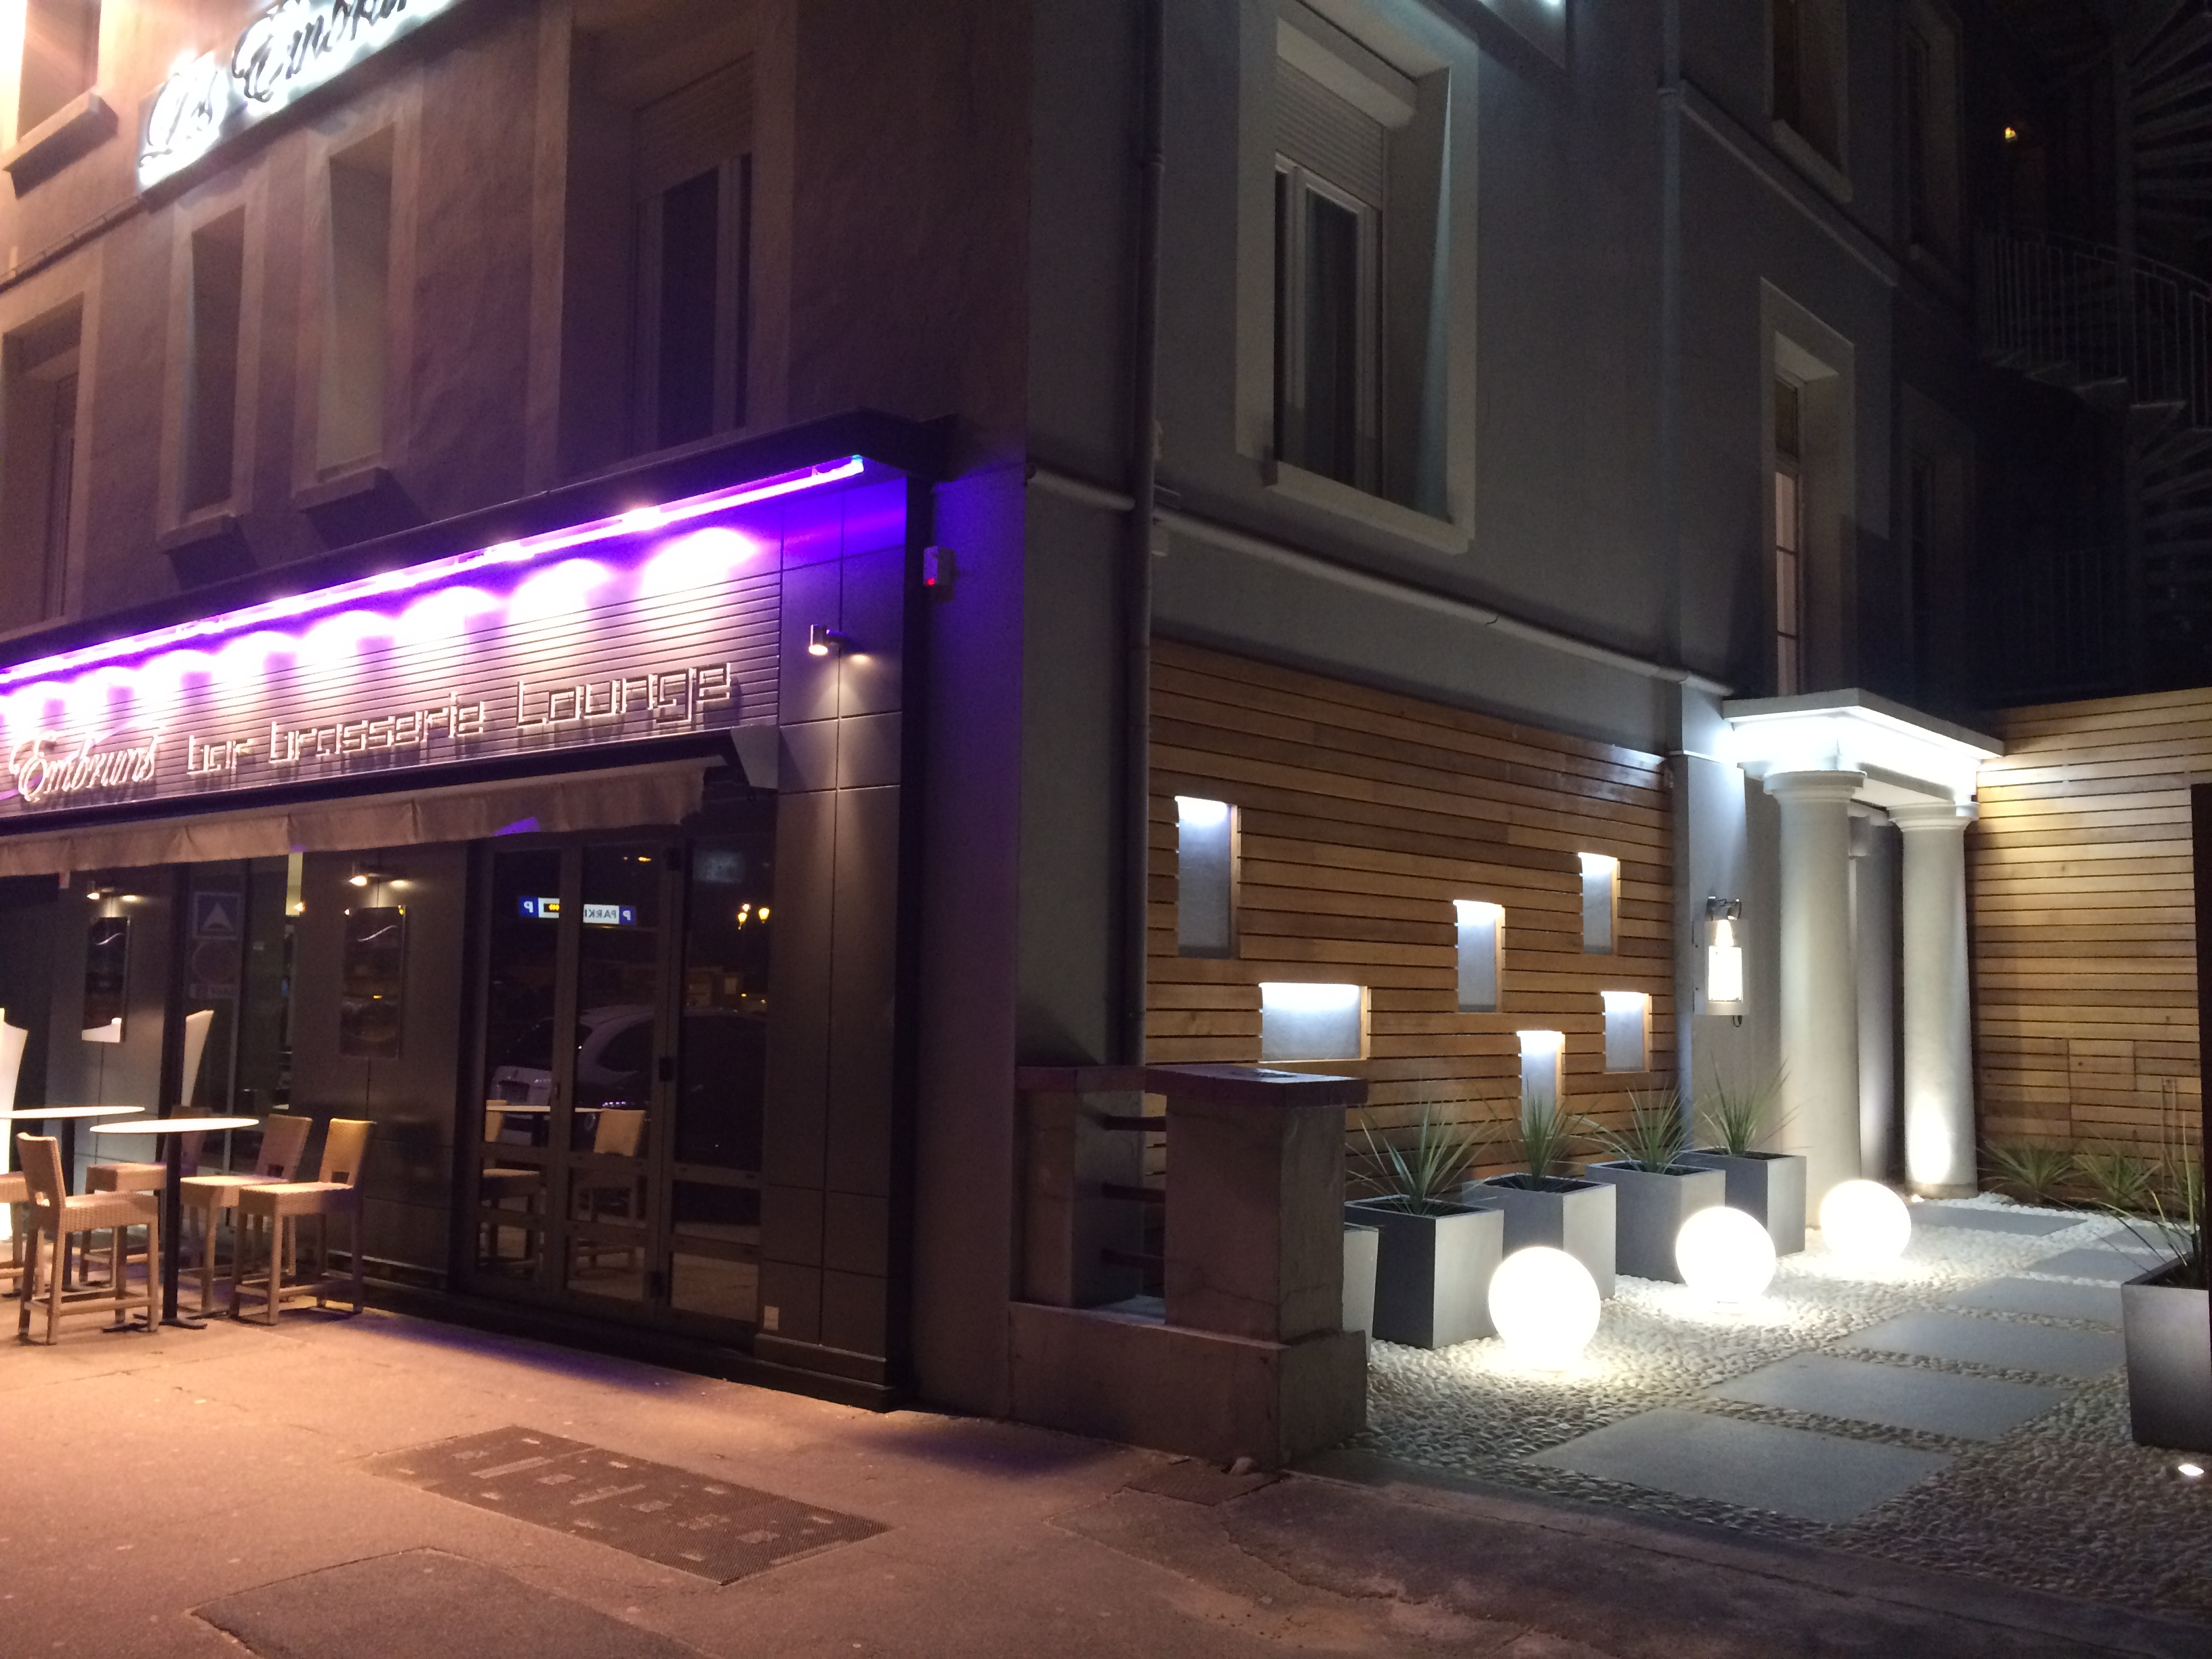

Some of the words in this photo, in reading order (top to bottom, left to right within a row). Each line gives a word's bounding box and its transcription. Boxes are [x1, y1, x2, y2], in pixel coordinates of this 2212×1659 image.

[187, 735, 254, 775] bar
[268, 691, 485, 764] brasserie
[517, 662, 731, 728] Lounge
